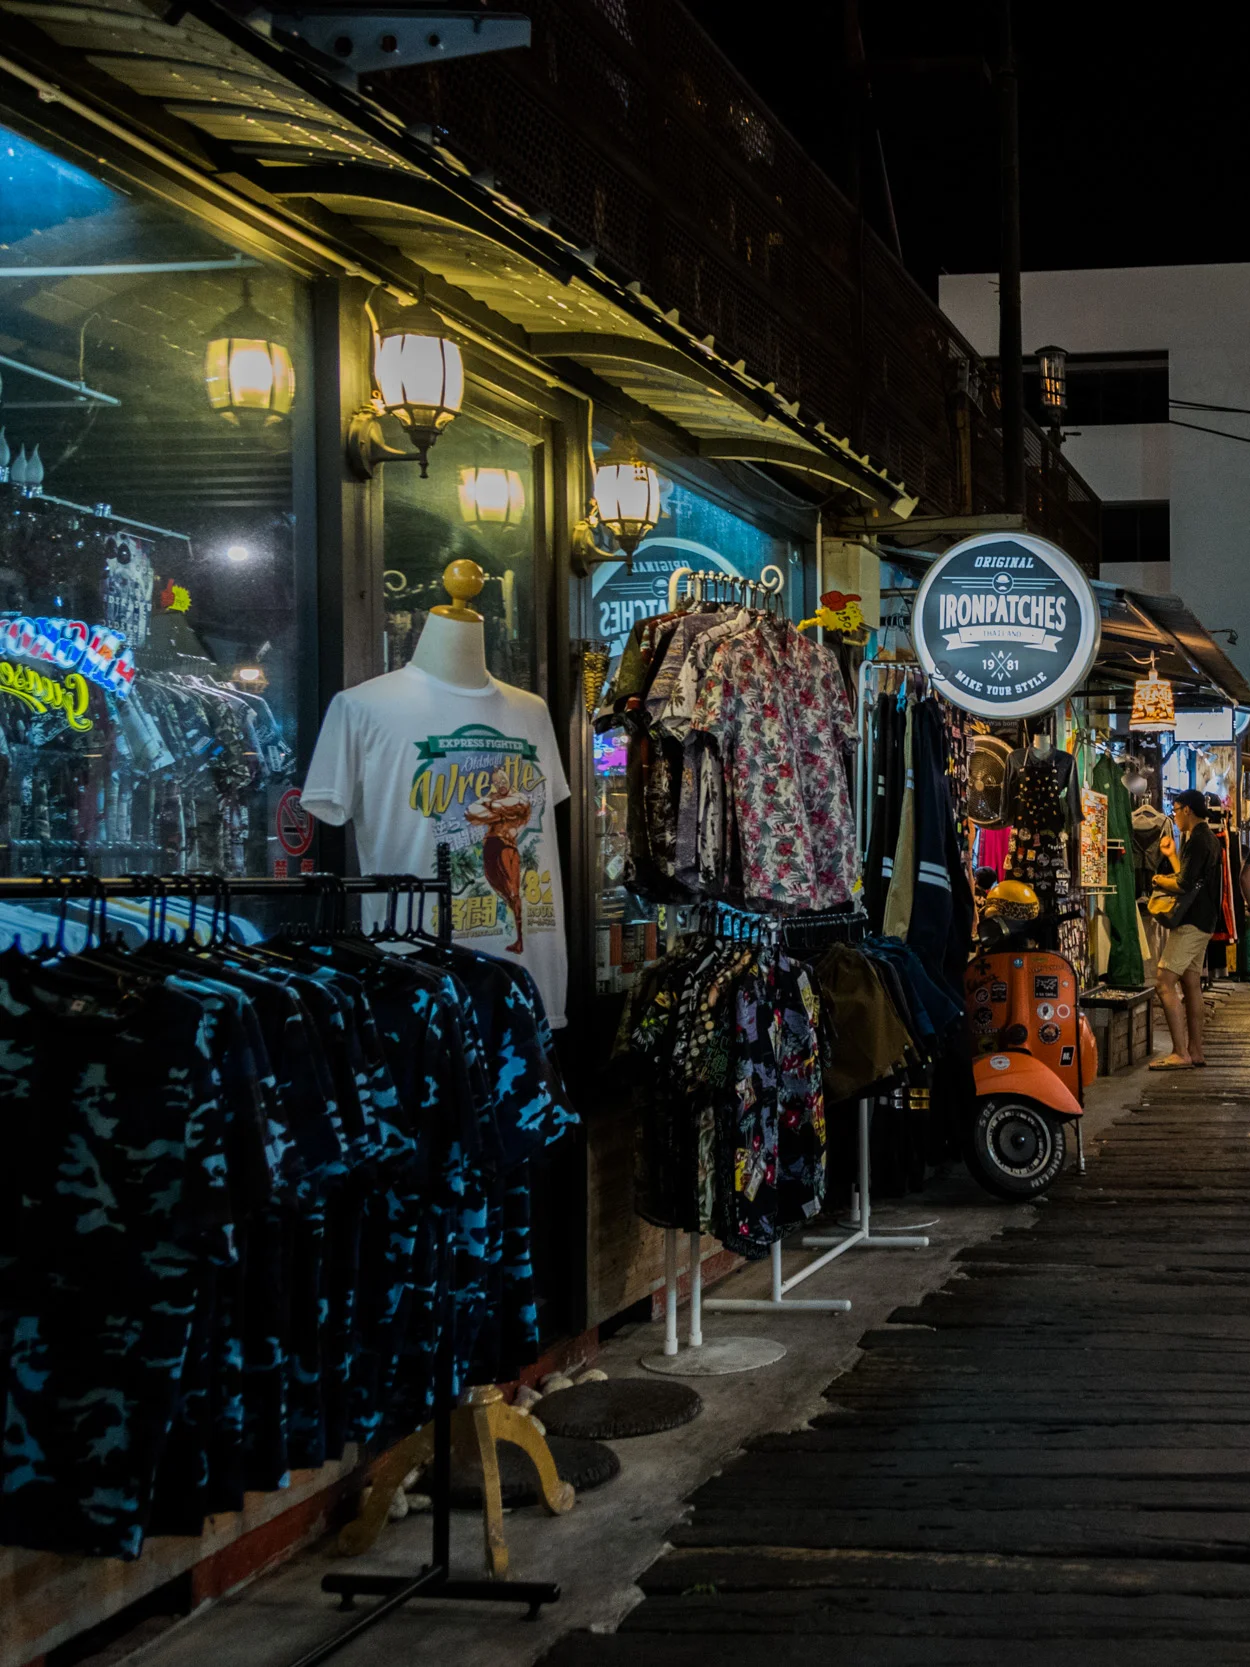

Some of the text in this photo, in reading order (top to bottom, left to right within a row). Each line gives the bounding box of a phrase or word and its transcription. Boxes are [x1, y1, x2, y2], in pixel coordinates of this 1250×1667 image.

[974, 556, 1034, 569] ORIGINAL
[939, 594, 1067, 632] IRONPATCHES
[982, 659, 1019, 670] 19 81
[955, 670, 1048, 696] MAKE YOUR STYLE
[438, 738, 524, 750] EXPRESS FIGHTER
[409, 755, 547, 818] Wretle
[1030, 1133, 1063, 1188] MICHELIN
